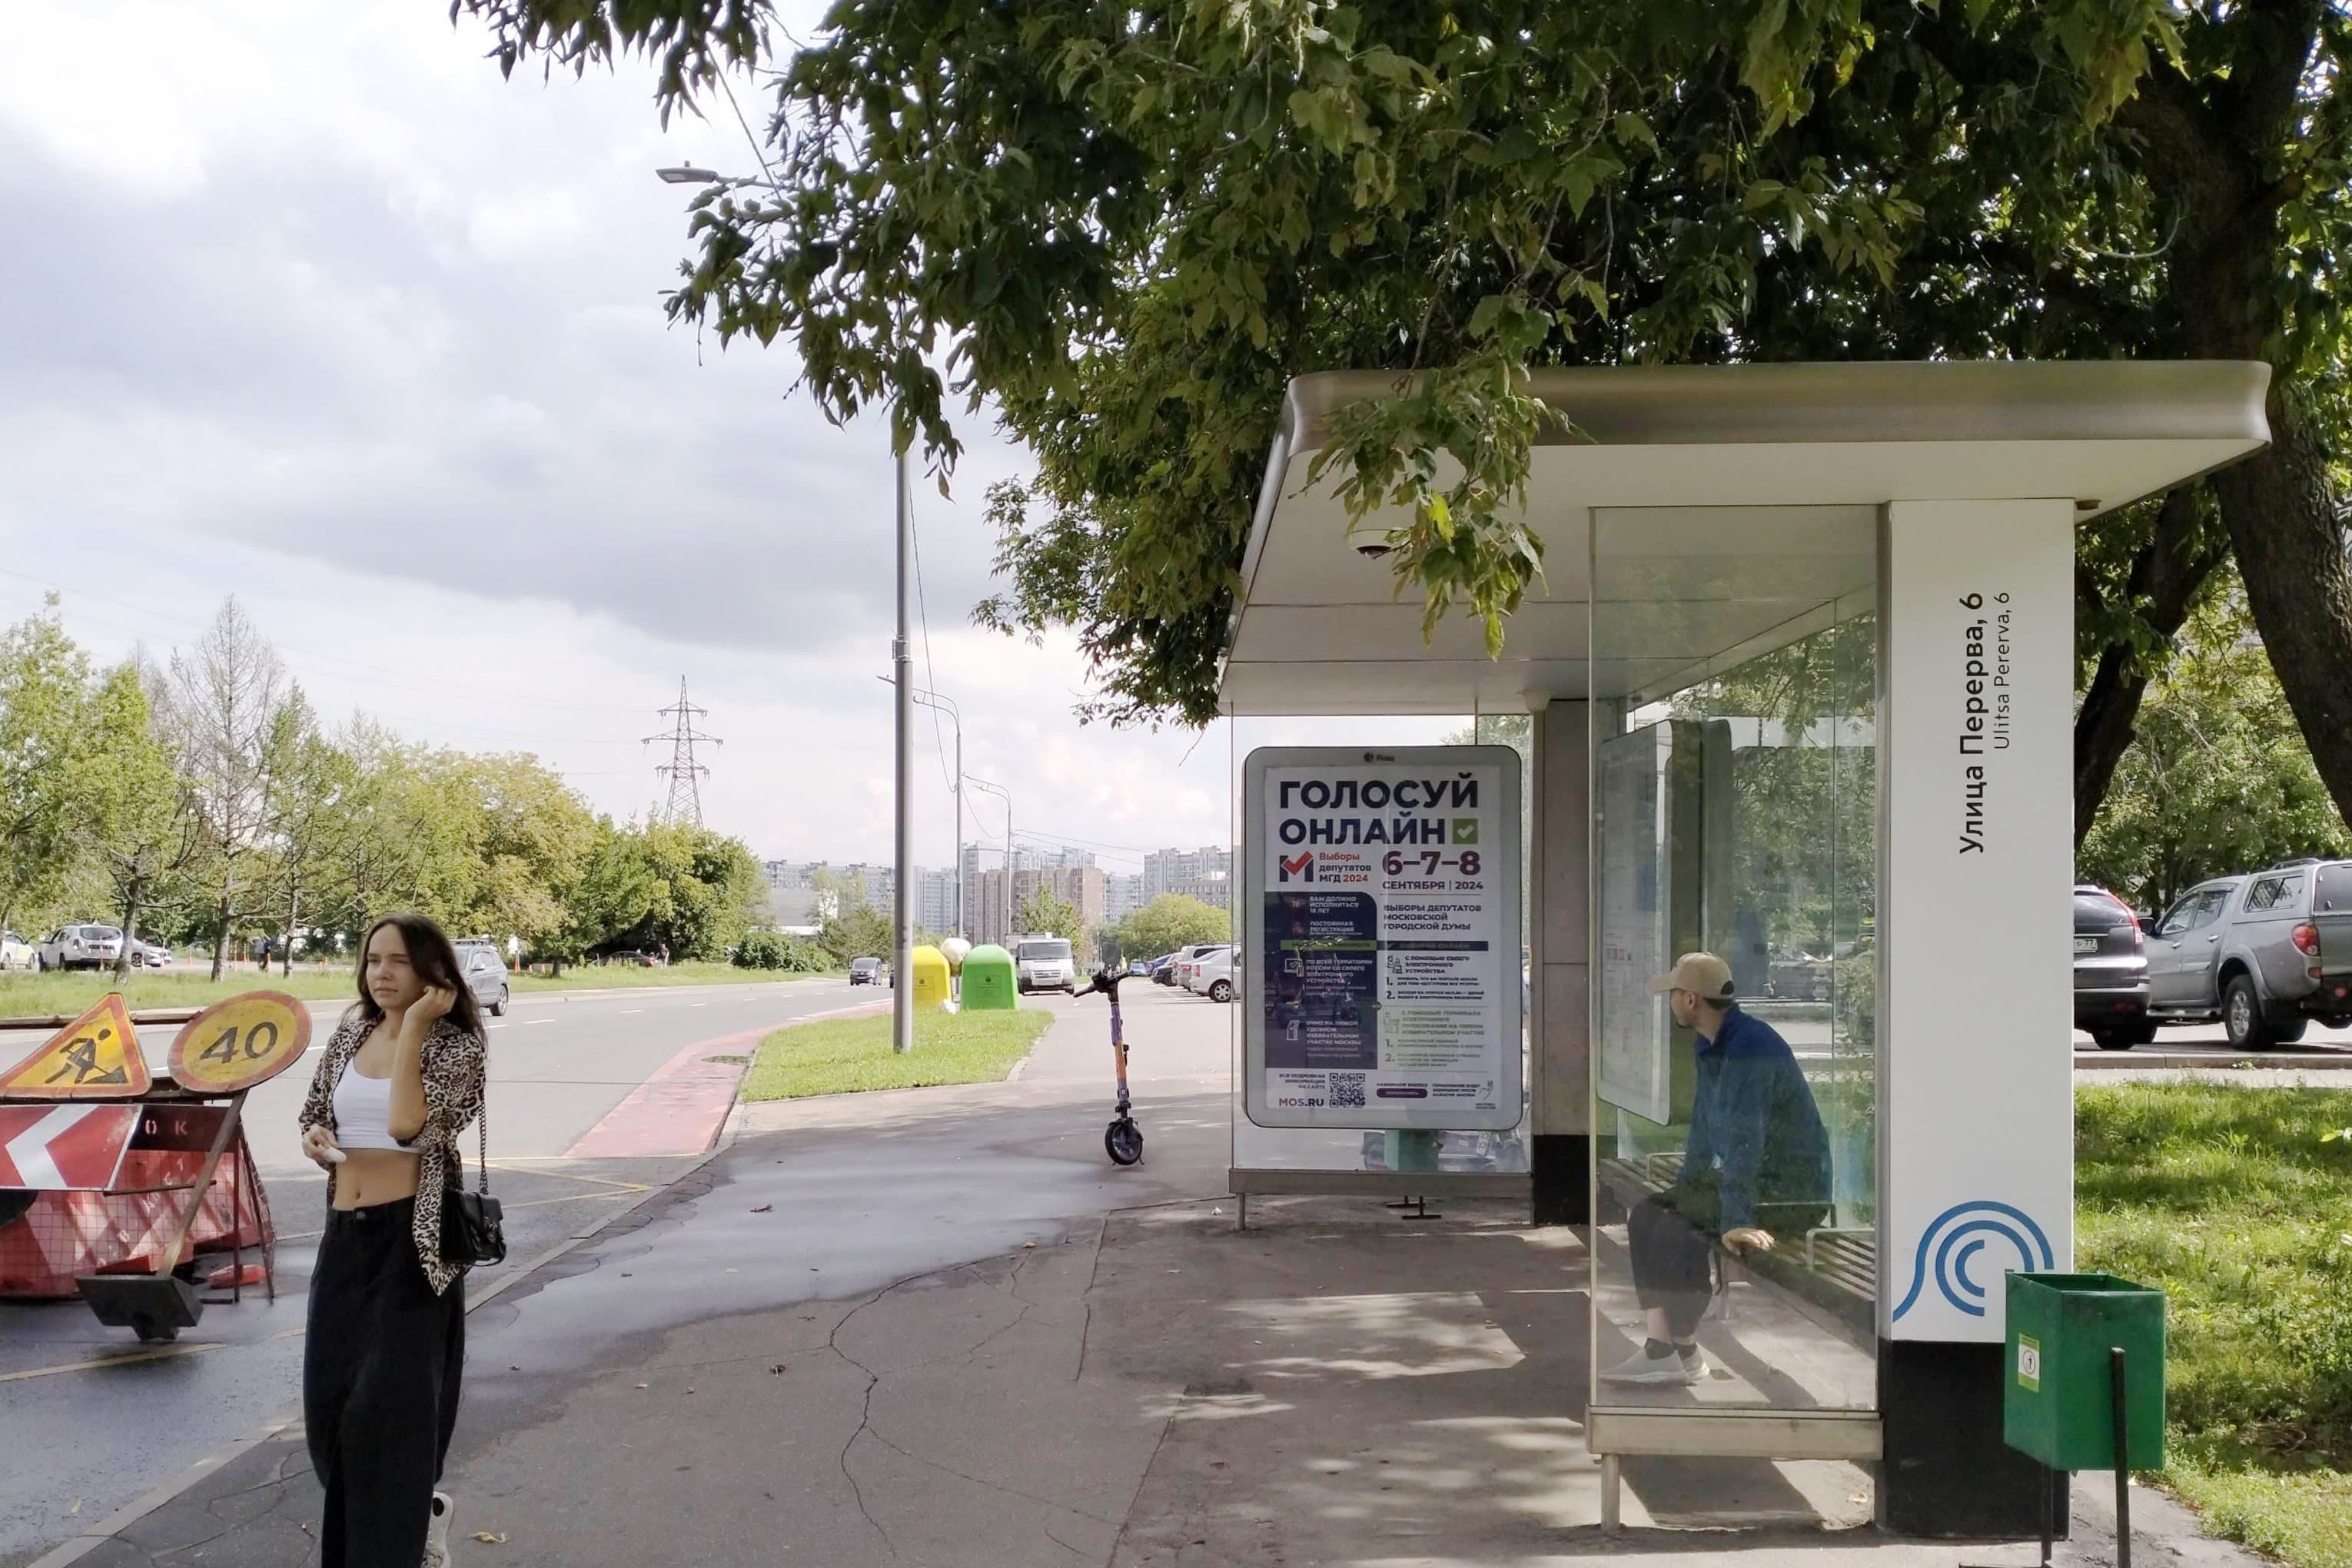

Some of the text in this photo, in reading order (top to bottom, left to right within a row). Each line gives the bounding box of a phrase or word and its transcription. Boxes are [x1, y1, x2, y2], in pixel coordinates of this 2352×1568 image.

[1993, 592, 2012, 749] Ulitsa Pererva, 6
[1959, 592, 1989, 855] Улица Перерва, 6
[1280, 772, 1478, 809] ГОЛОСУЙ
[1279, 811, 1445, 845] ОНЛАЙН
[1319, 852, 1360, 862] Выборы
[1318, 864, 1372, 872] депутатов
[1319, 874, 1368, 883] МГД 2024
[1382, 881, 1483, 889] СЕНТЯБРЯ 2024
[1384, 922, 1440, 930] ГОРОДСКОЙ
[201, 1021, 279, 1064] 40
[1279, 1098, 1324, 1107] MOS.RU
